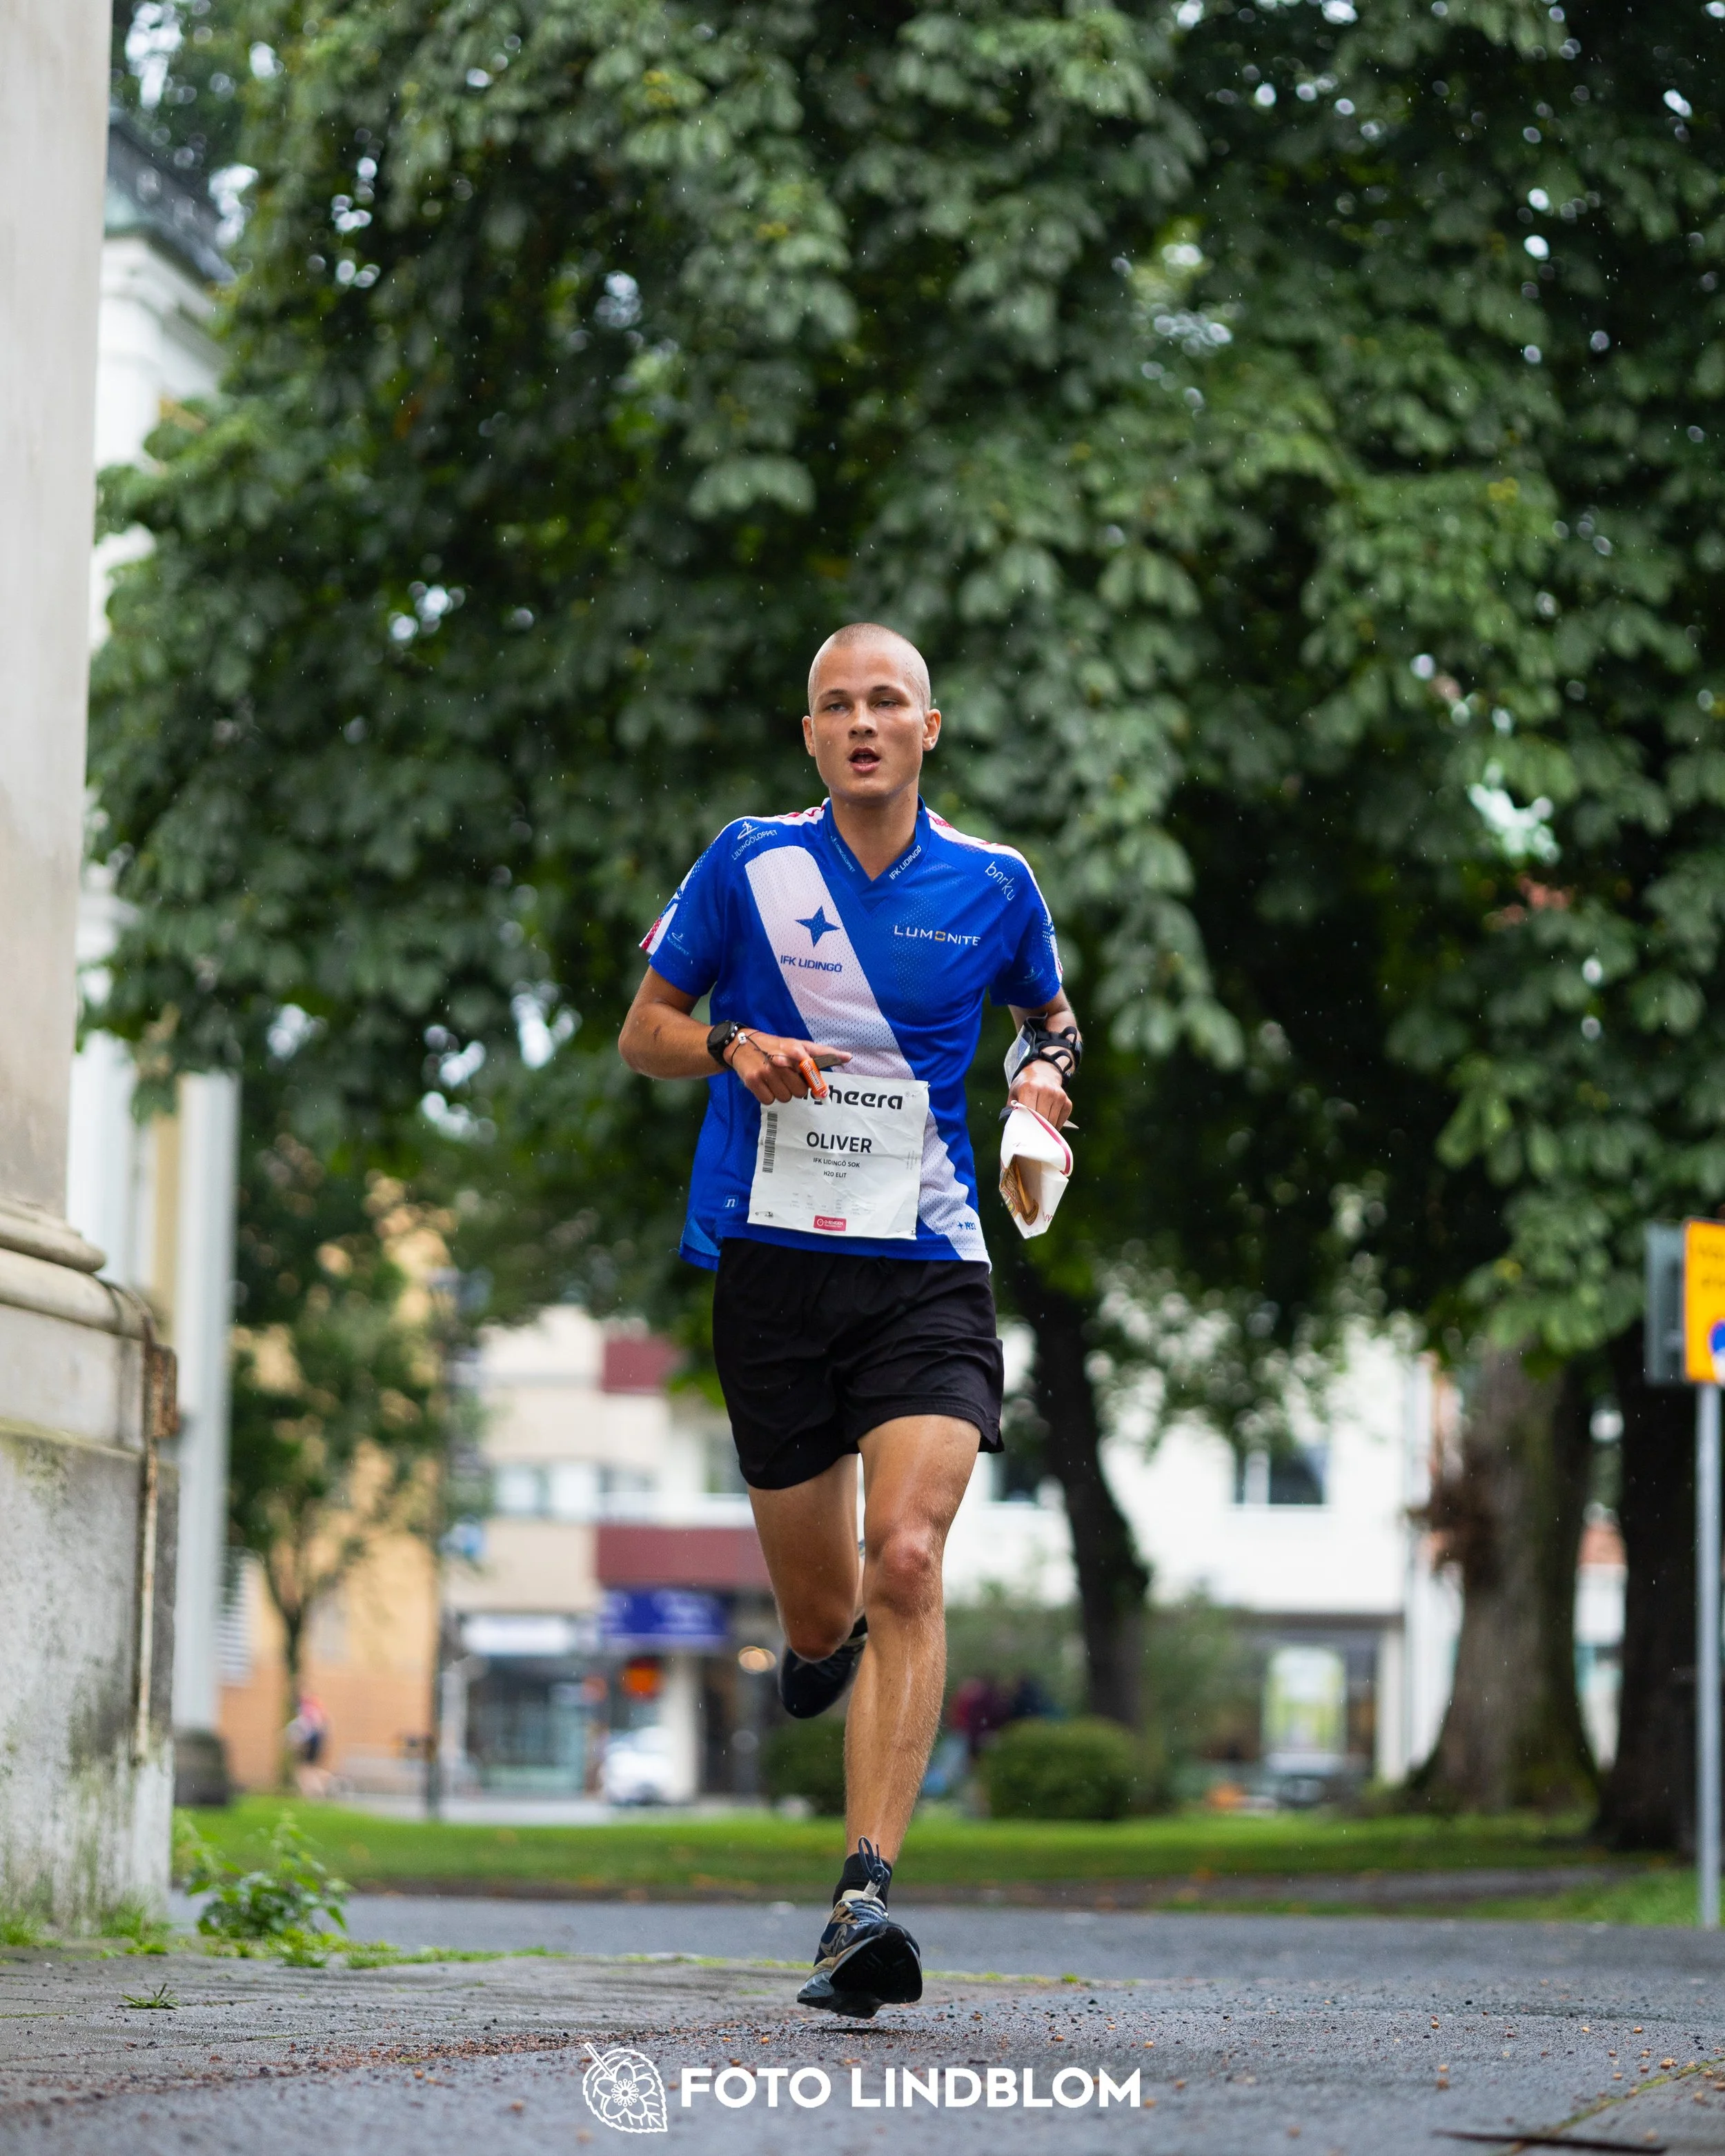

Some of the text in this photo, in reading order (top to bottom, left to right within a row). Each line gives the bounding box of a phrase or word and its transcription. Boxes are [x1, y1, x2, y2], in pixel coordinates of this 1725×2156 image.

[731, 829, 778, 860] LIDINGÖLOPPET
[889, 868, 901, 880] IFK
[894, 925, 981, 946] LUMONITE
[780, 955, 842, 973] IFK LIDINGÖ
[803, 1085, 903, 1109] heera
[806, 1131, 872, 1154] OLIVER
